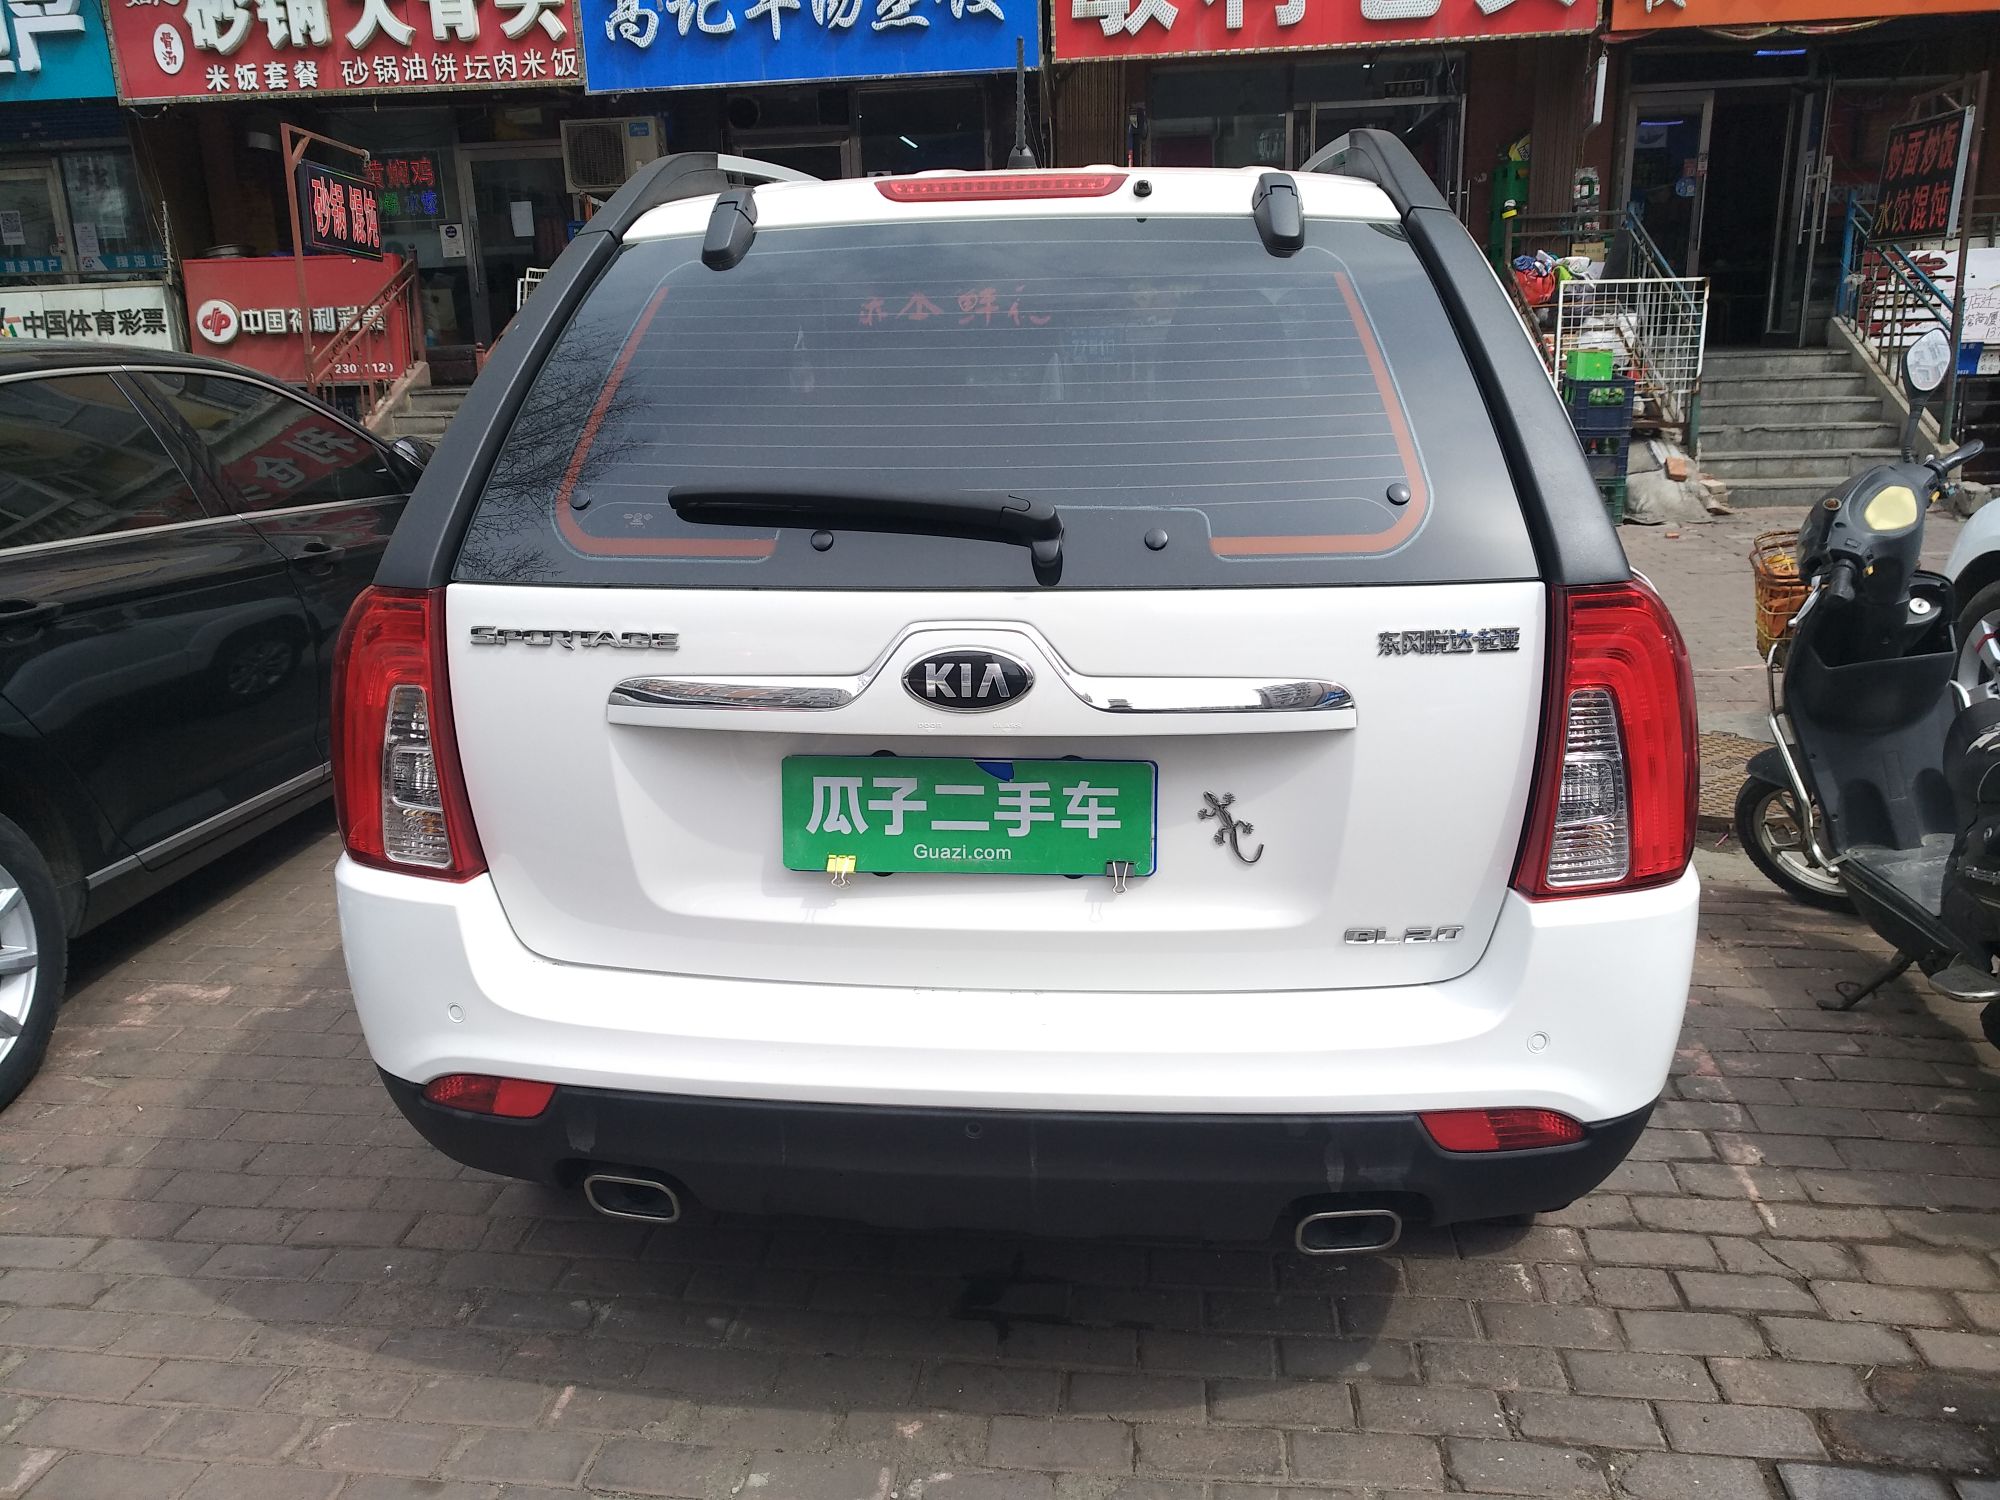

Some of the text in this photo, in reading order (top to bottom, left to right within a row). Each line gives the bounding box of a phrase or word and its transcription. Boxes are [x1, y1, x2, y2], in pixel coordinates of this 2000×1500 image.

[206, 48, 579, 92] 米饭套餐 砂锅油饼坛肉米饭
[1884, 121, 1960, 182] 炒面炒饭
[311, 176, 348, 241] 砂锅
[1873, 181, 1951, 235] 水饺馄饨
[22, 308, 167, 339] 中国体育彩票
[470, 625, 680, 650] SPORTAGE
[924, 663, 1011, 698] KIA
[805, 776, 1122, 840] 瓜子二手车
[913, 843, 1012, 861] Guazi.com
